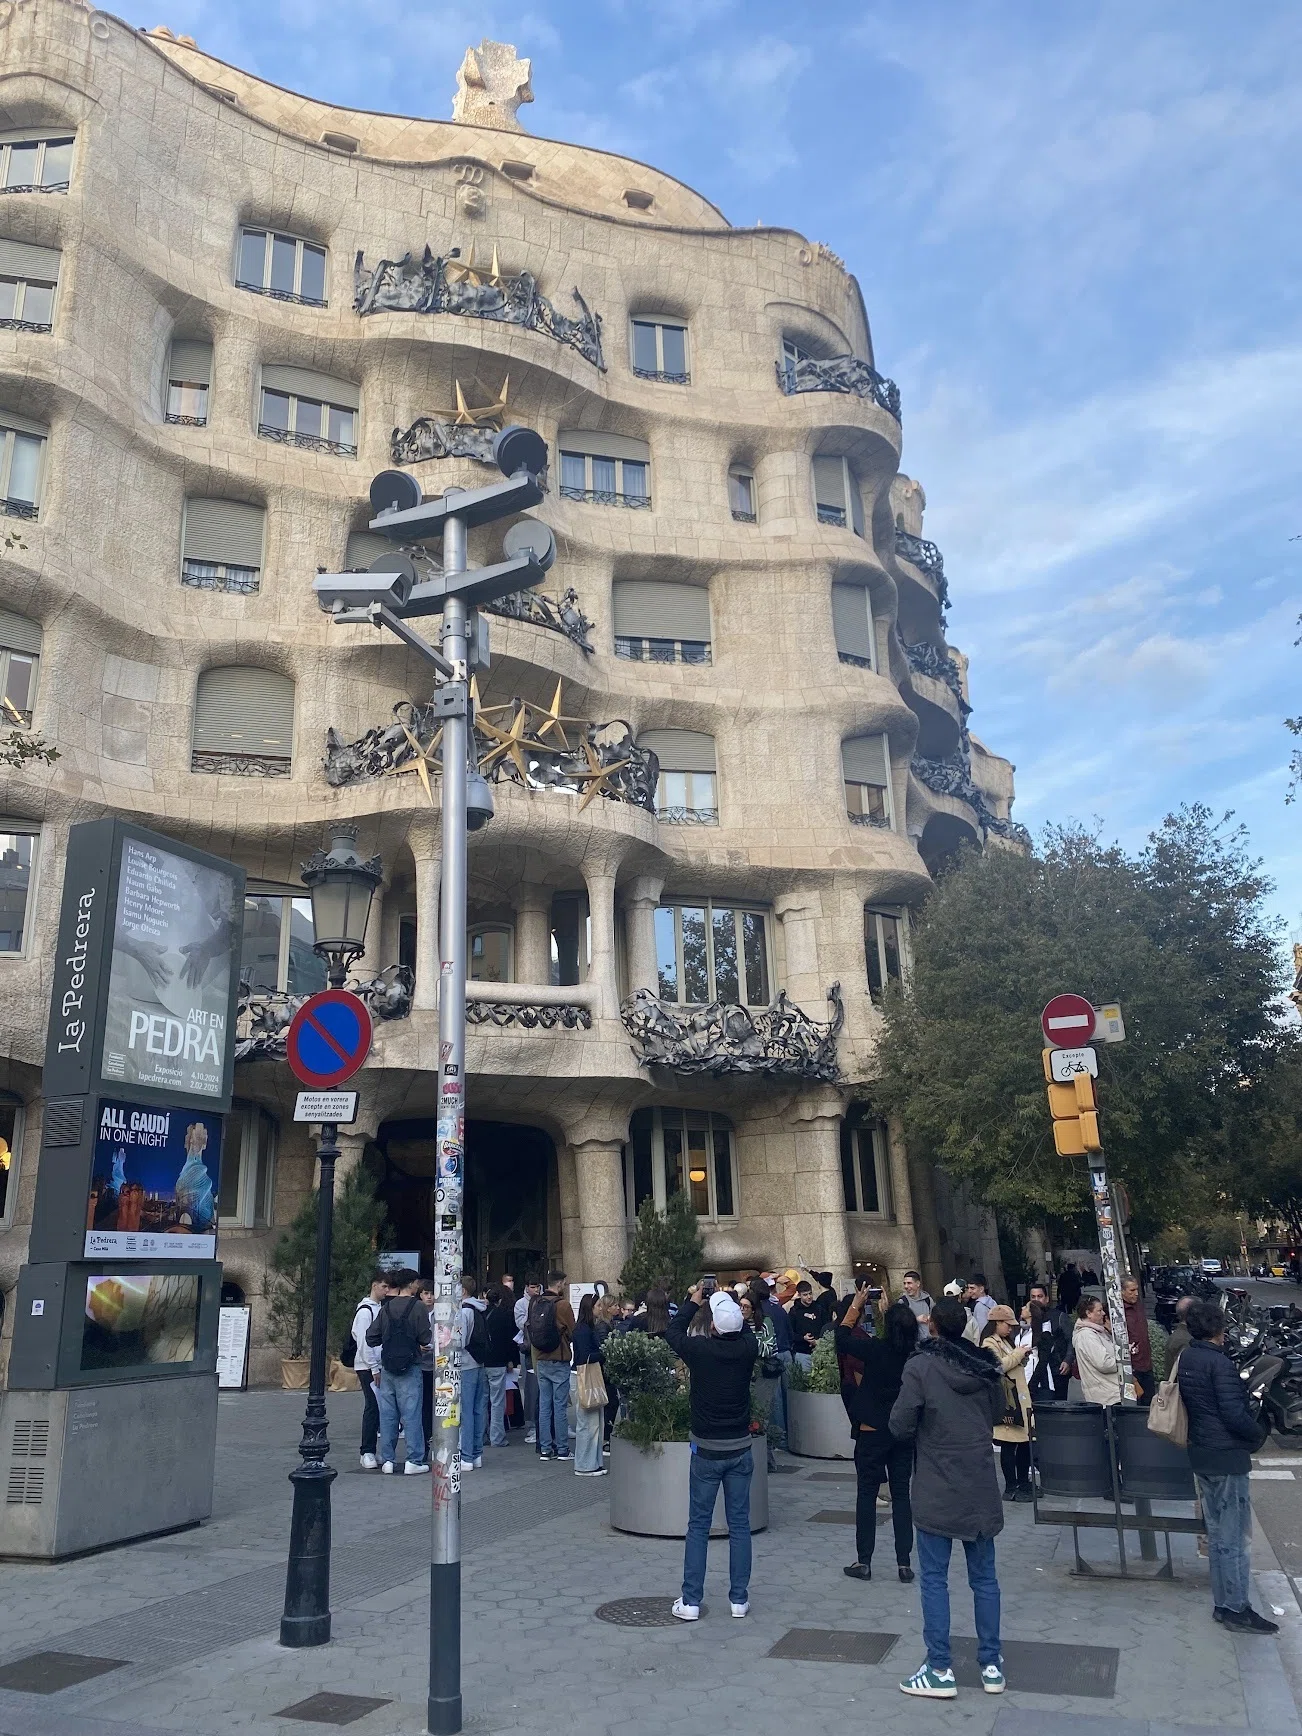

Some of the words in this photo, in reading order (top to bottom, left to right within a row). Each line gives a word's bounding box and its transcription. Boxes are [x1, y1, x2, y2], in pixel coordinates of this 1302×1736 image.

[128, 845, 144, 857] Hans
[145, 852, 157, 864] Arp
[127, 856, 148, 869] Louise
[148, 863, 178, 880] Bourgeois
[127, 866, 153, 881] Eduardo
[154, 875, 176, 890] Chillida
[126, 876, 145, 889] Naum
[146, 883, 162, 895] Gabo
[124, 897, 144, 910] Henry
[144, 903, 165, 917] Moore
[125, 886, 150, 901] Barbara
[151, 894, 180, 912] Hepworth
[122, 918, 139, 930] Jorge
[141, 923, 160, 936] Oteiza
[123, 907, 142, 919] Isamu
[143, 913, 169, 928] Noguchi
[62, 887, 96, 1017] Pedrera
[187, 1008, 209, 1026] ART
[210, 1013, 224, 1030] EN
[58, 1018, 86, 1053] La
[128, 1010, 220, 1066] PEDRA
[138, 1071, 182, 1086] lapedrera.com
[155, 1064, 183, 1077] Exposició
[191, 1071, 219, 1083] 4.10.2024
[189, 1081, 219, 1092] 2.02.2025
[101, 1107, 126, 1129] ALL
[130, 1111, 171, 1135] GAUDÍ
[100, 1127, 111, 1140] IN
[113, 1128, 136, 1144] ONE
[138, 1132, 169, 1147] NIGHT
[96, 1236, 117, 1245] Pedrera
